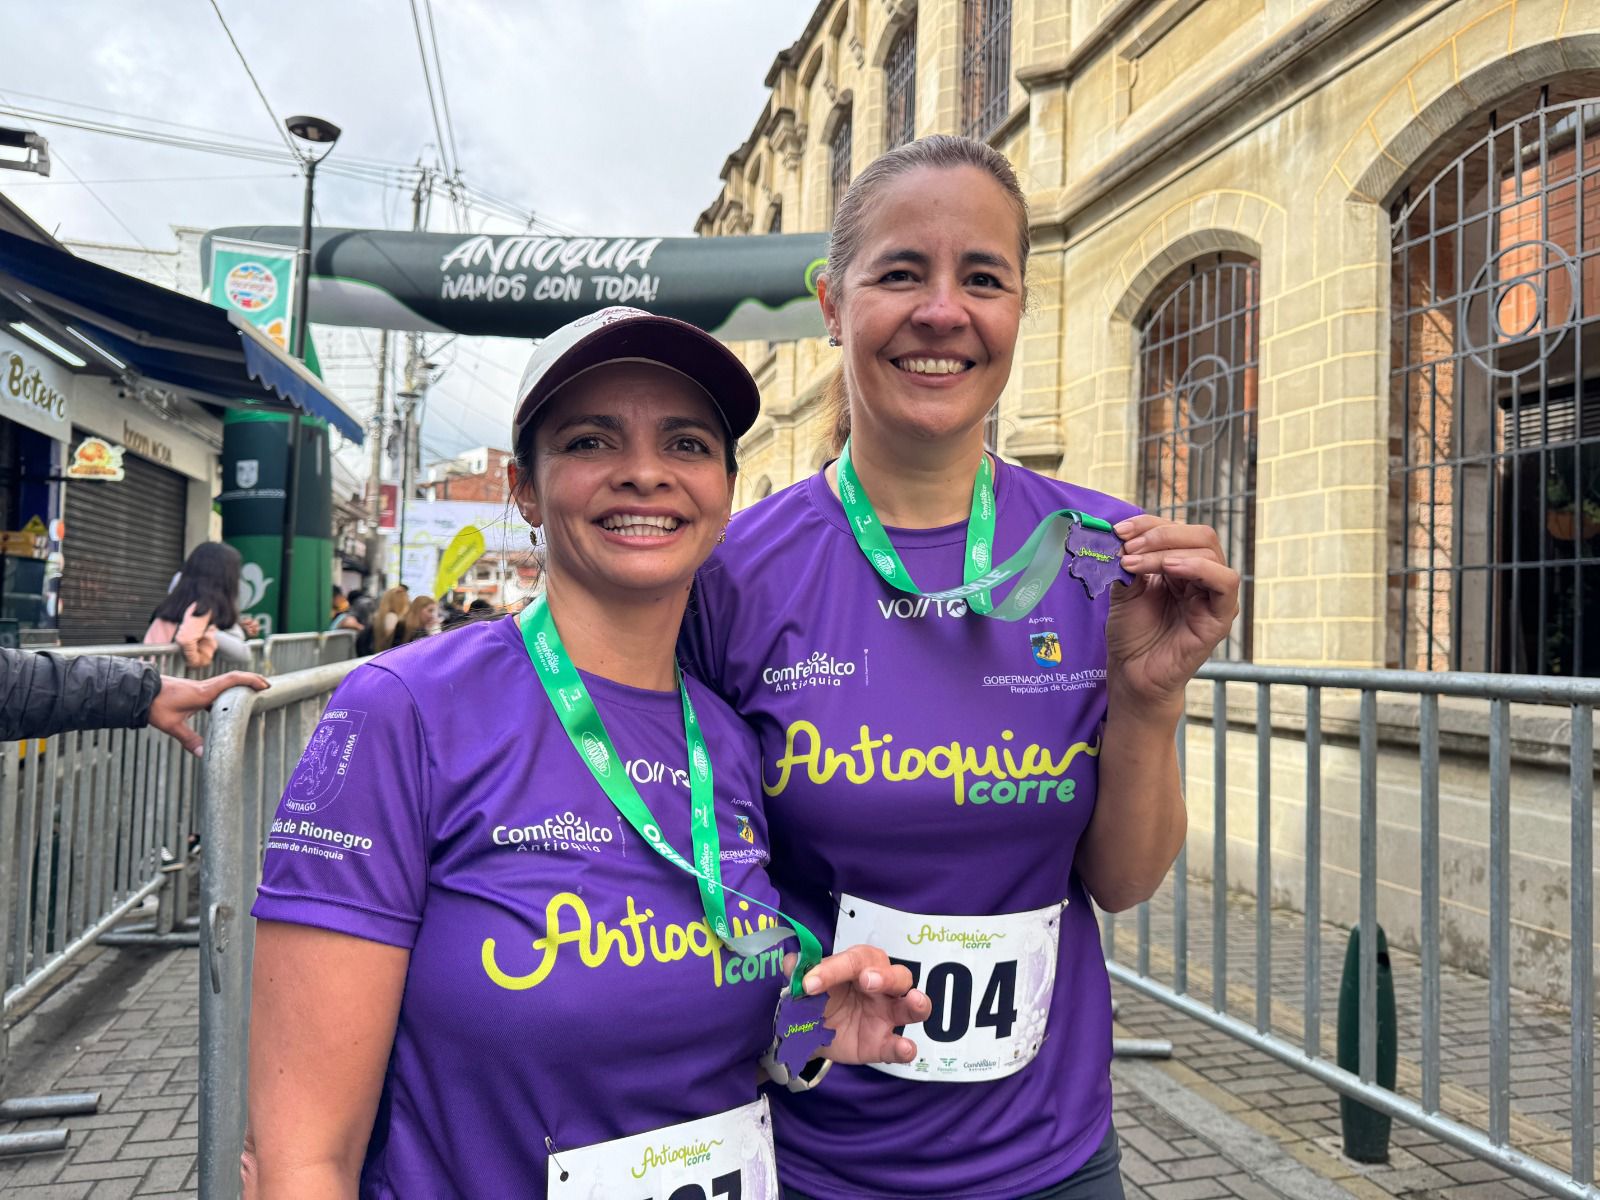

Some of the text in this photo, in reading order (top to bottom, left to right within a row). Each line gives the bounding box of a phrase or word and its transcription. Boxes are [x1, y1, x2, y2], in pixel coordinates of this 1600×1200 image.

[440, 235, 663, 274] ANTIOQUIA
[533, 275, 583, 302] CON
[591, 273, 660, 303] TODA!
[8, 353, 65, 418] Botero
[536, 631, 560, 675] Comfenalco
[762, 655, 856, 685] Comfenalco
[775, 675, 841, 693] Antioquia
[983, 672, 1054, 685] GOBERNACIÓN
[1056, 672, 1068, 682] DE
[1061, 680, 1097, 692] Colombia
[337, 733, 358, 775] DE ARMA
[762, 720, 1101, 806] Antioquia
[285, 798, 317, 812] SANTIAGO
[968, 778, 1076, 805] corre
[283, 818, 297, 834] de
[299, 820, 373, 850] Rionegro
[492, 817, 613, 846] Comfenalco
[290, 842, 300, 852] de
[301, 844, 344, 861] Antioquia
[516, 840, 601, 853] Antioquia
[907, 924, 1006, 950] Antioquia
[631, 1139, 725, 1179] Antioquia
[687, 1152, 712, 1167] corre
